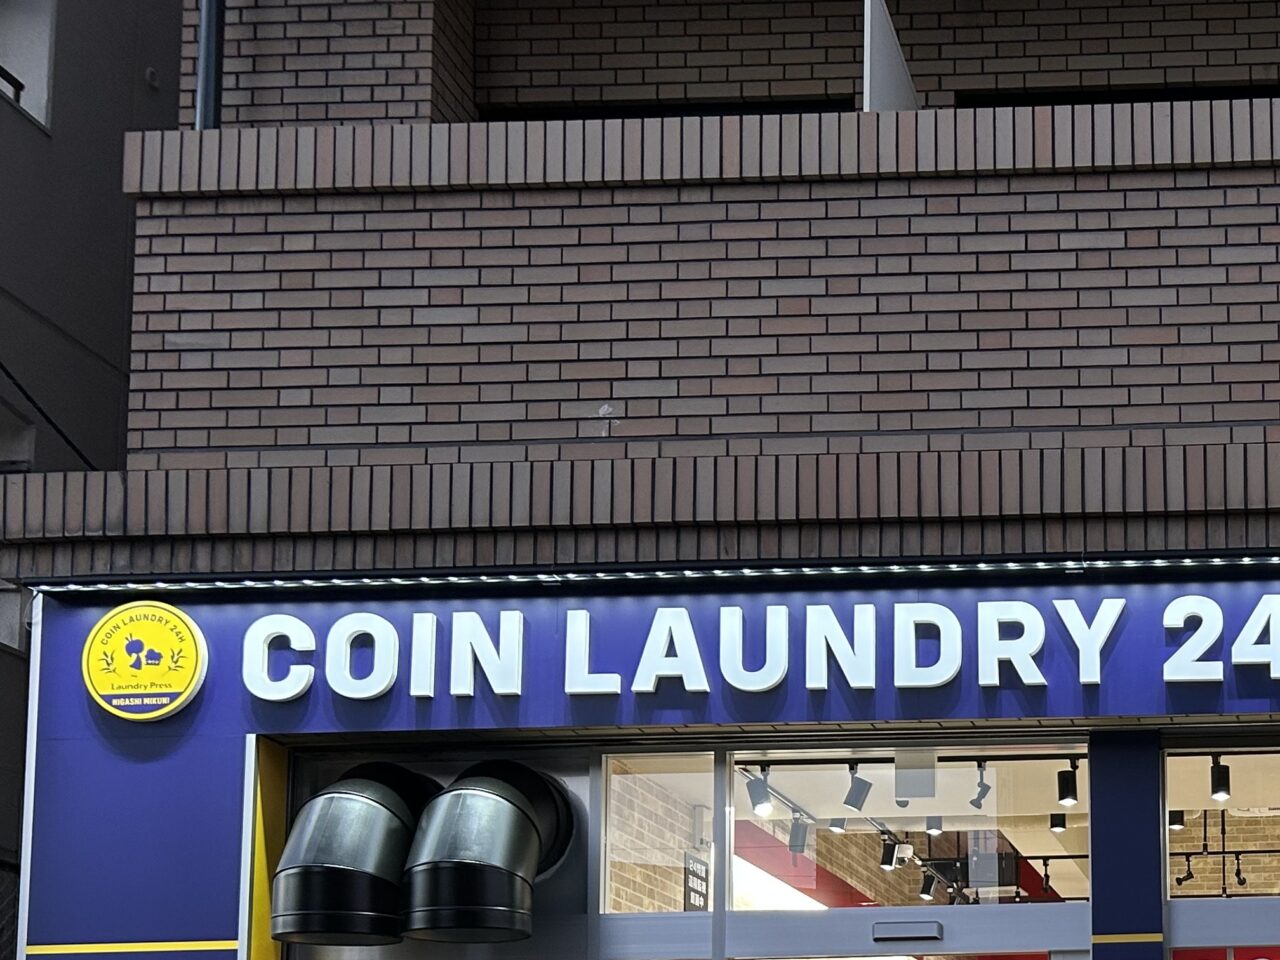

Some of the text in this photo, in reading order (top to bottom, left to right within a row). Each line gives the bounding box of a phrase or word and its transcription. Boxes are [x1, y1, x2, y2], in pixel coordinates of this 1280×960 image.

[101, 613, 186, 646] COIN LAUNDRY 24H
[242, 610, 524, 702] COIN
[564, 598, 1126, 696] LAUNDRY
[111, 682, 149, 691] Laundry
